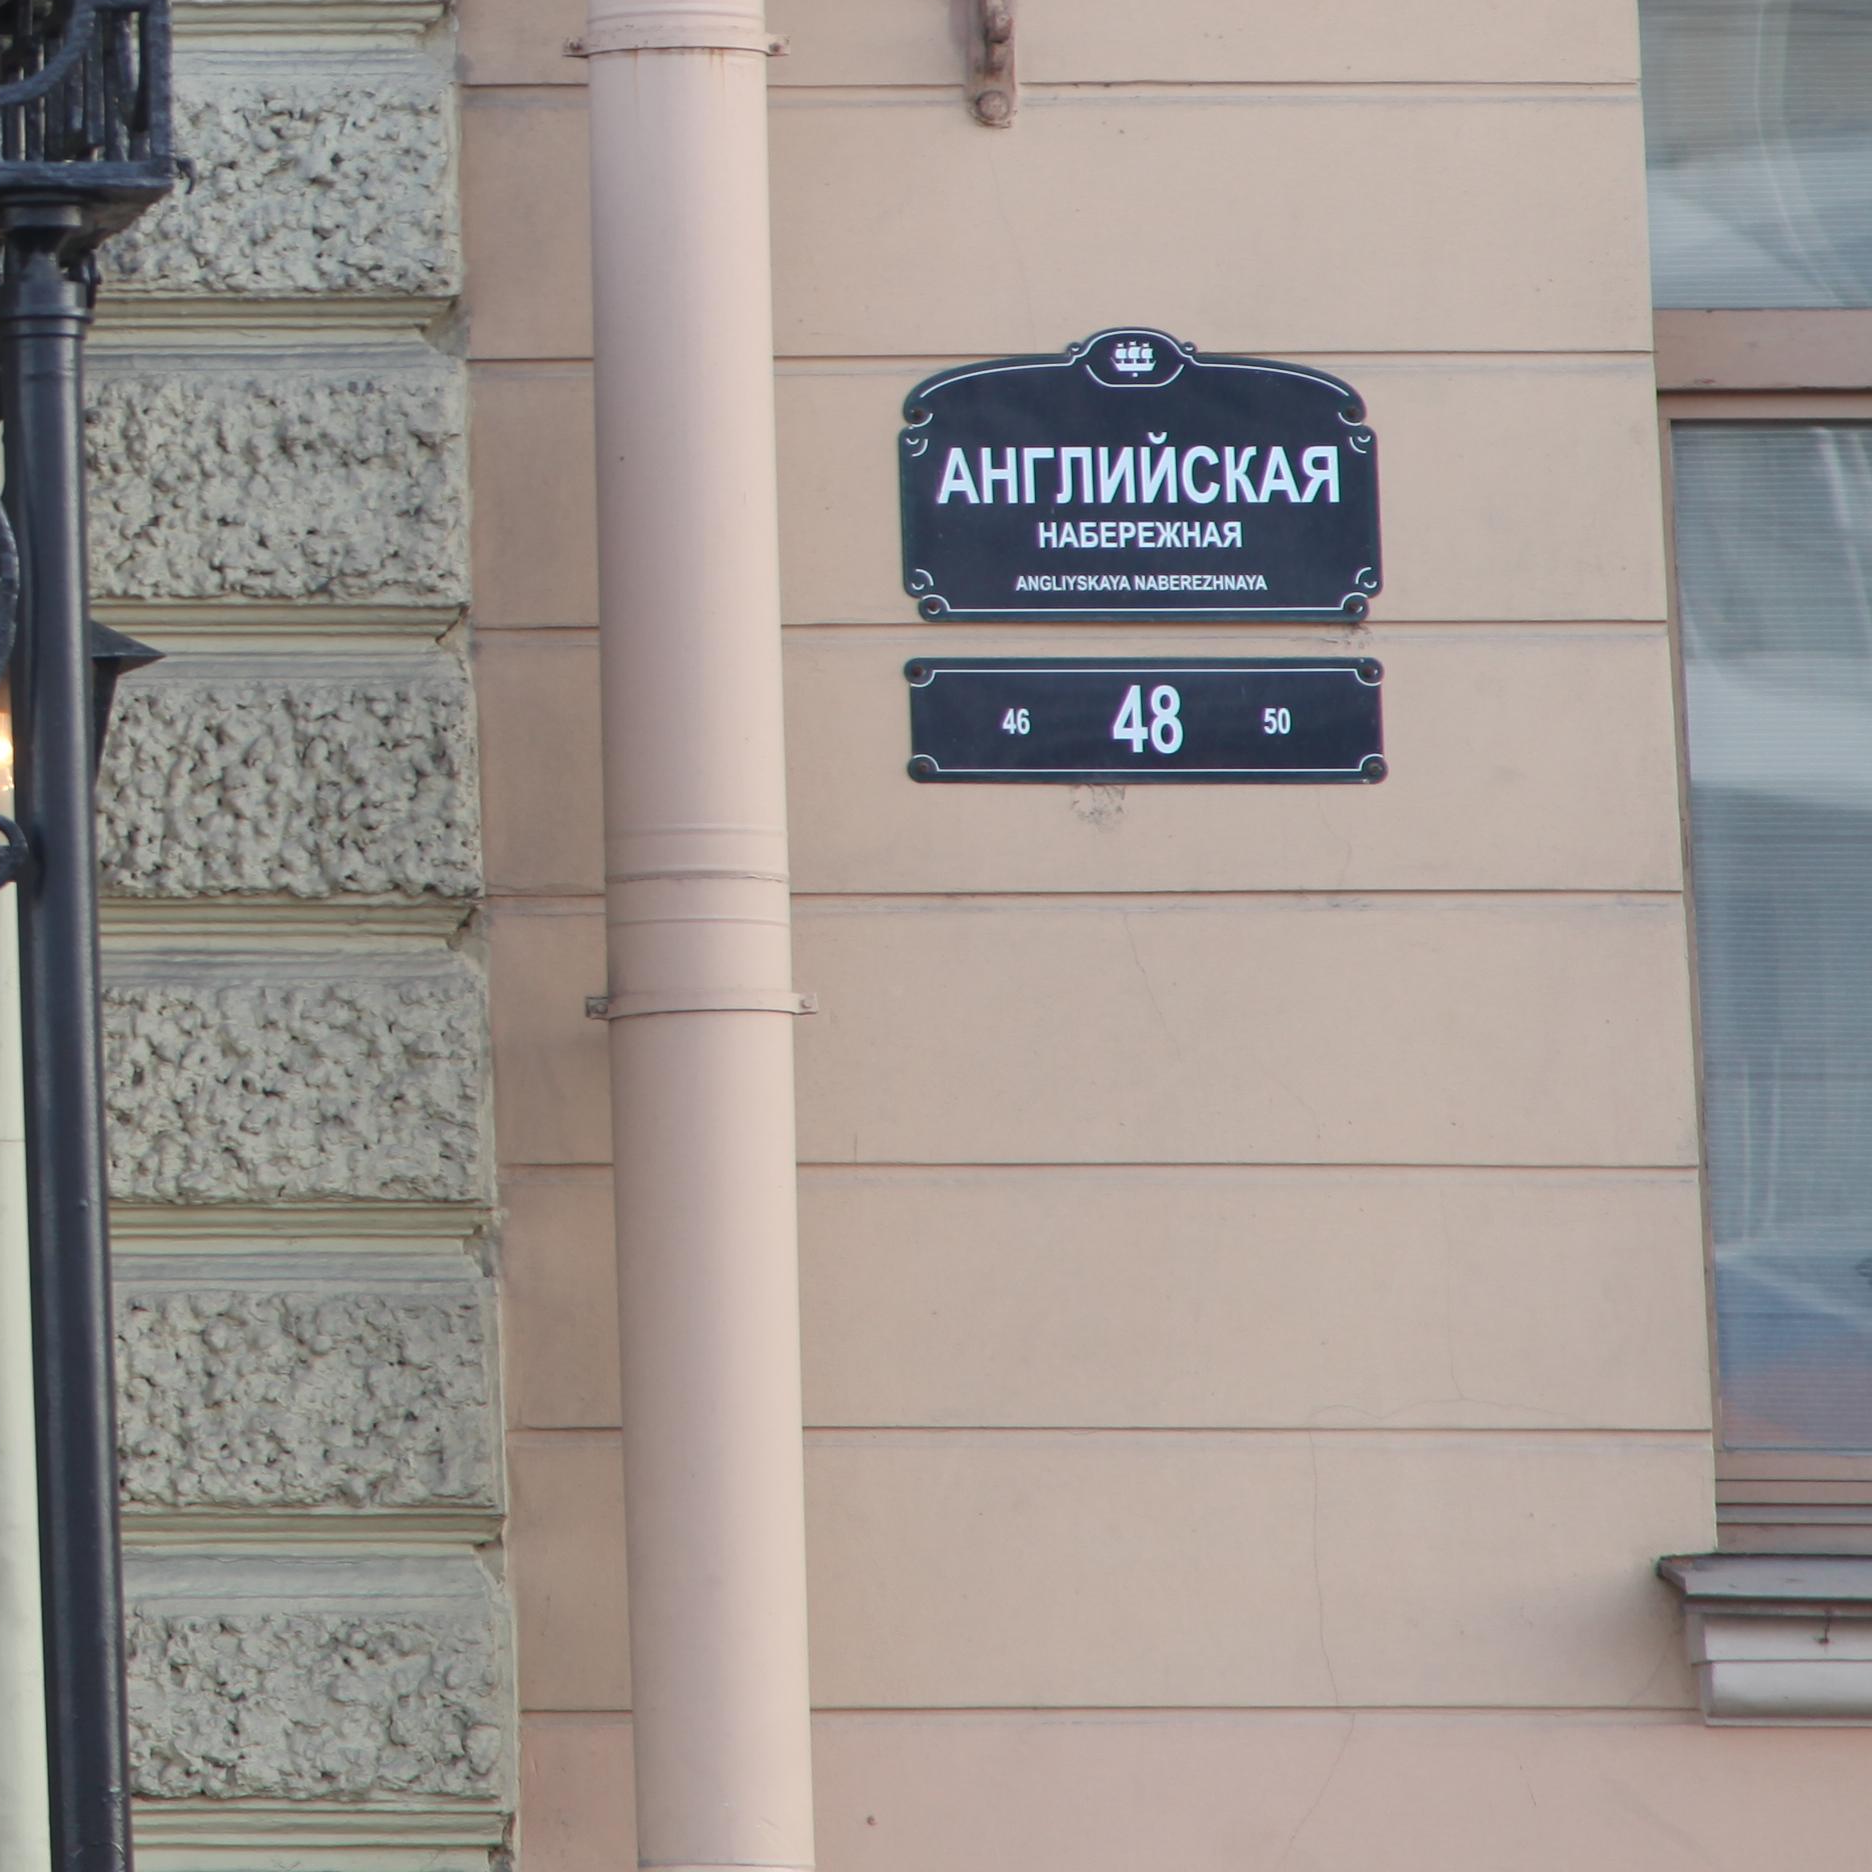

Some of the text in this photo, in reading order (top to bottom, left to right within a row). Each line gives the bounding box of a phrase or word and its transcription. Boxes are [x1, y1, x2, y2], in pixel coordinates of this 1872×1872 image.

[936, 431, 1341, 504] АНГЛИЙСКАЯ
[1038, 521, 1243, 549] НАБЕРЕЖНАЯ
[1015, 574, 1268, 592] ANGLIYSKAYA NABEREZHNAYA
[1002, 684, 1292, 754] 46 48 50
